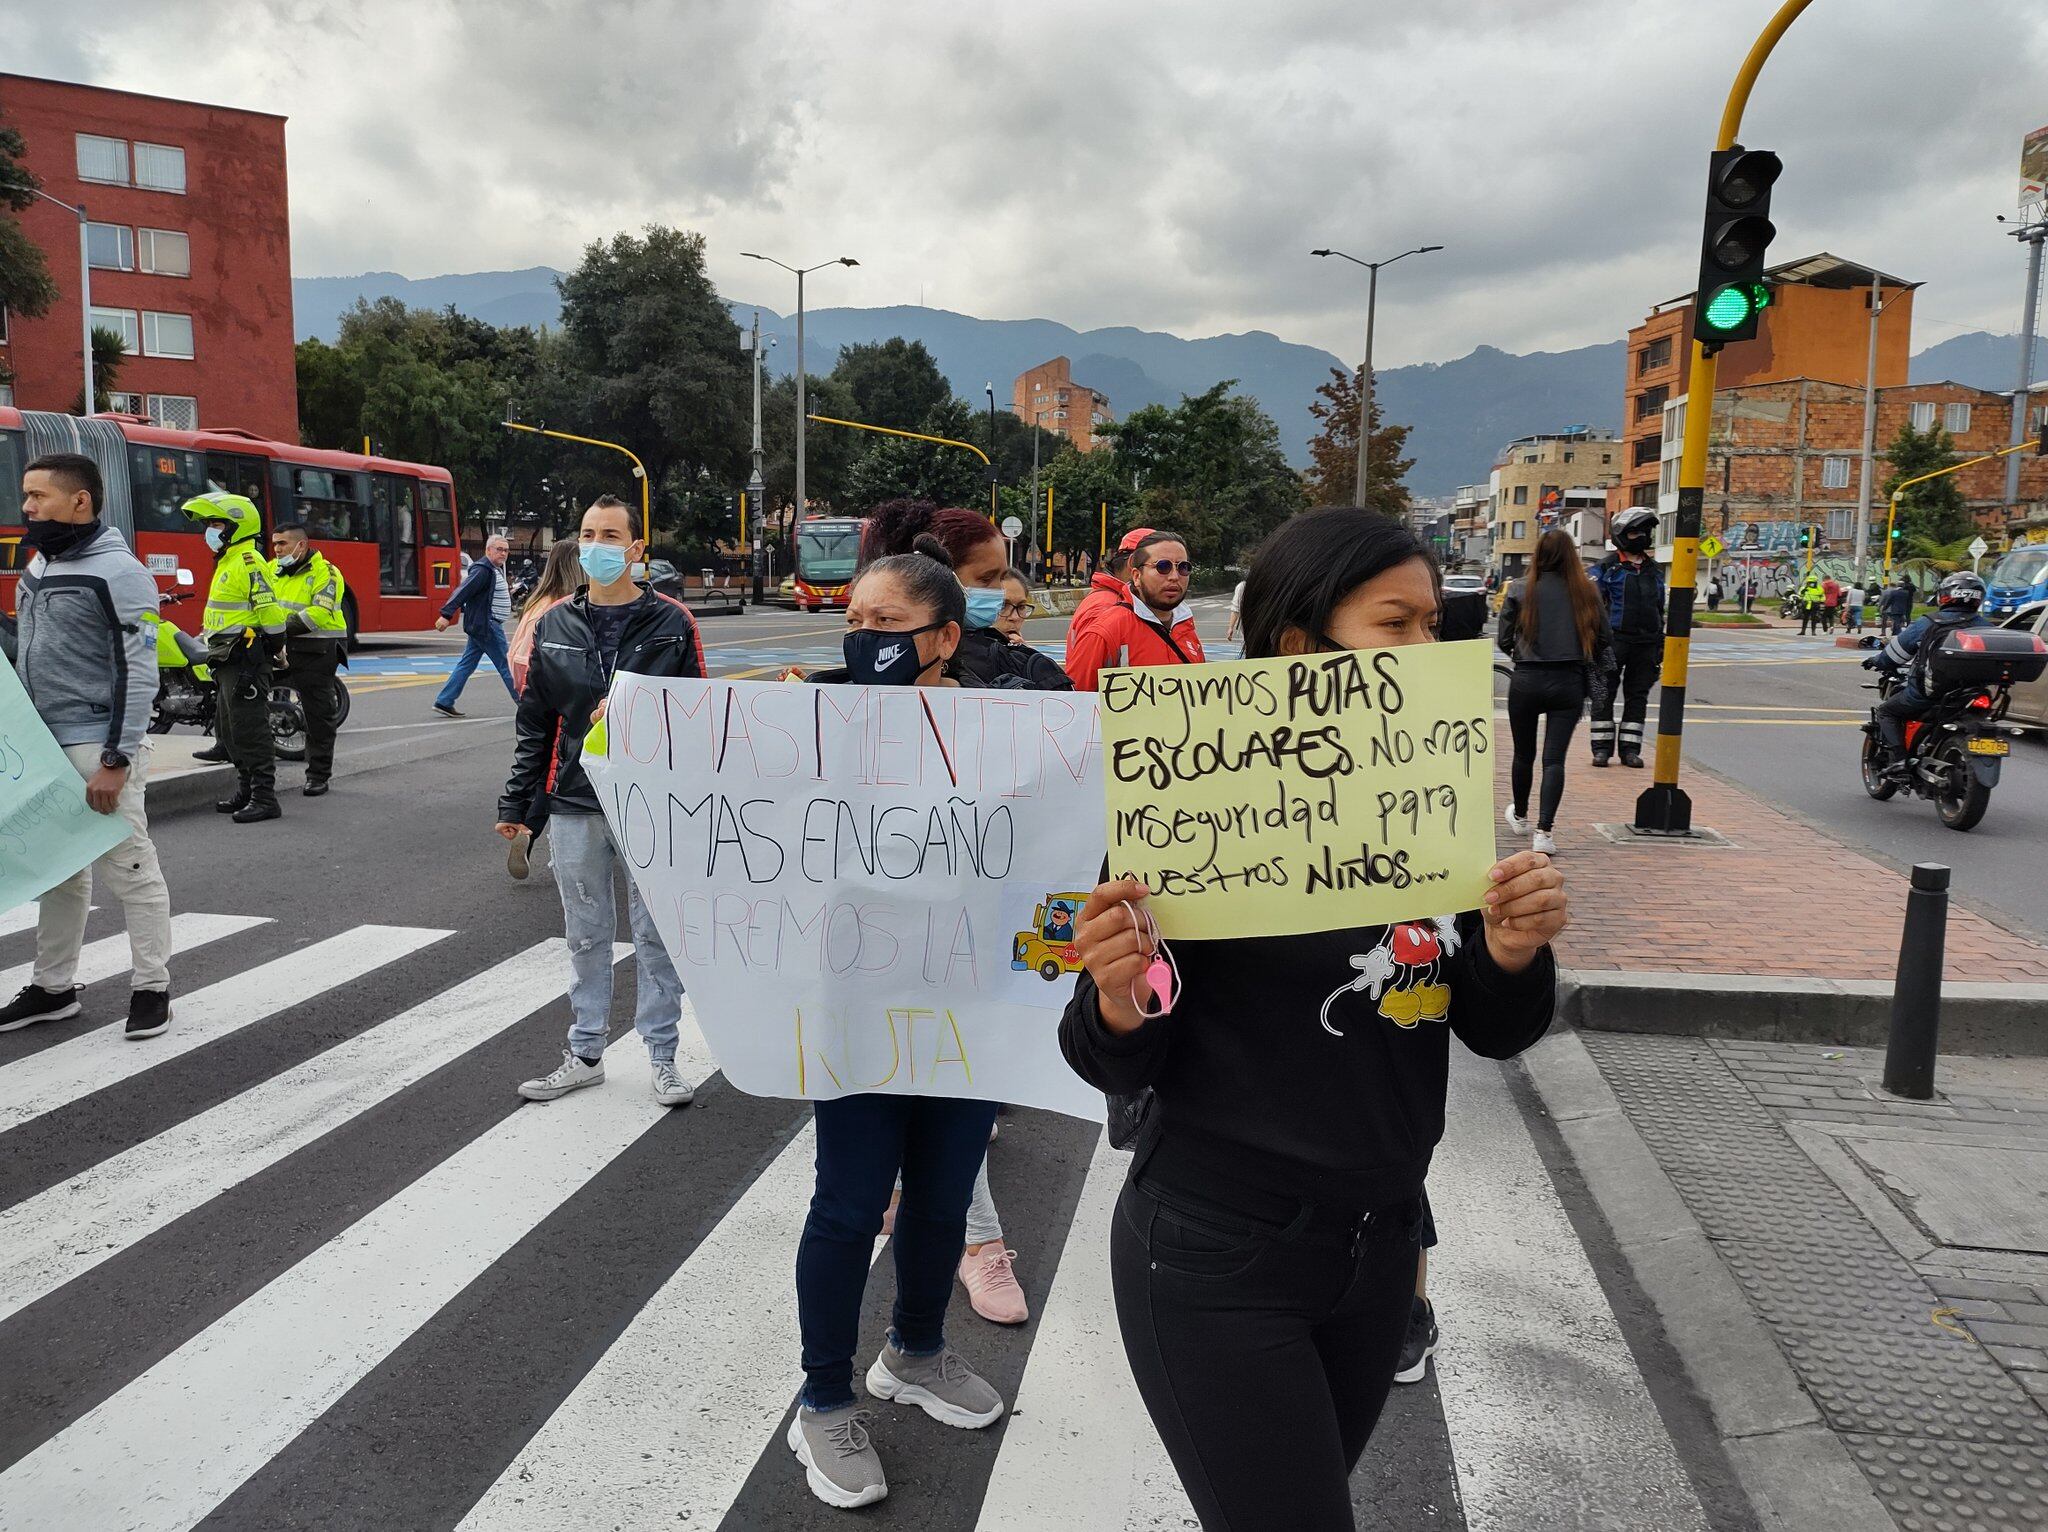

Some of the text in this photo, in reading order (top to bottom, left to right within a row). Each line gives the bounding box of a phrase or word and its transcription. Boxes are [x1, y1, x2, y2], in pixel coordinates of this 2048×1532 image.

[878, 643, 900, 661] NIKE
[606, 681, 662, 764] NO
[663, 686, 800, 779] MAS
[668, 793, 785, 883] MAS
[801, 796, 1014, 883] ENGAÑO
[1376, 784, 1458, 845] para
[921, 905, 978, 989] LA
[795, 1002, 974, 1096] RUTA
